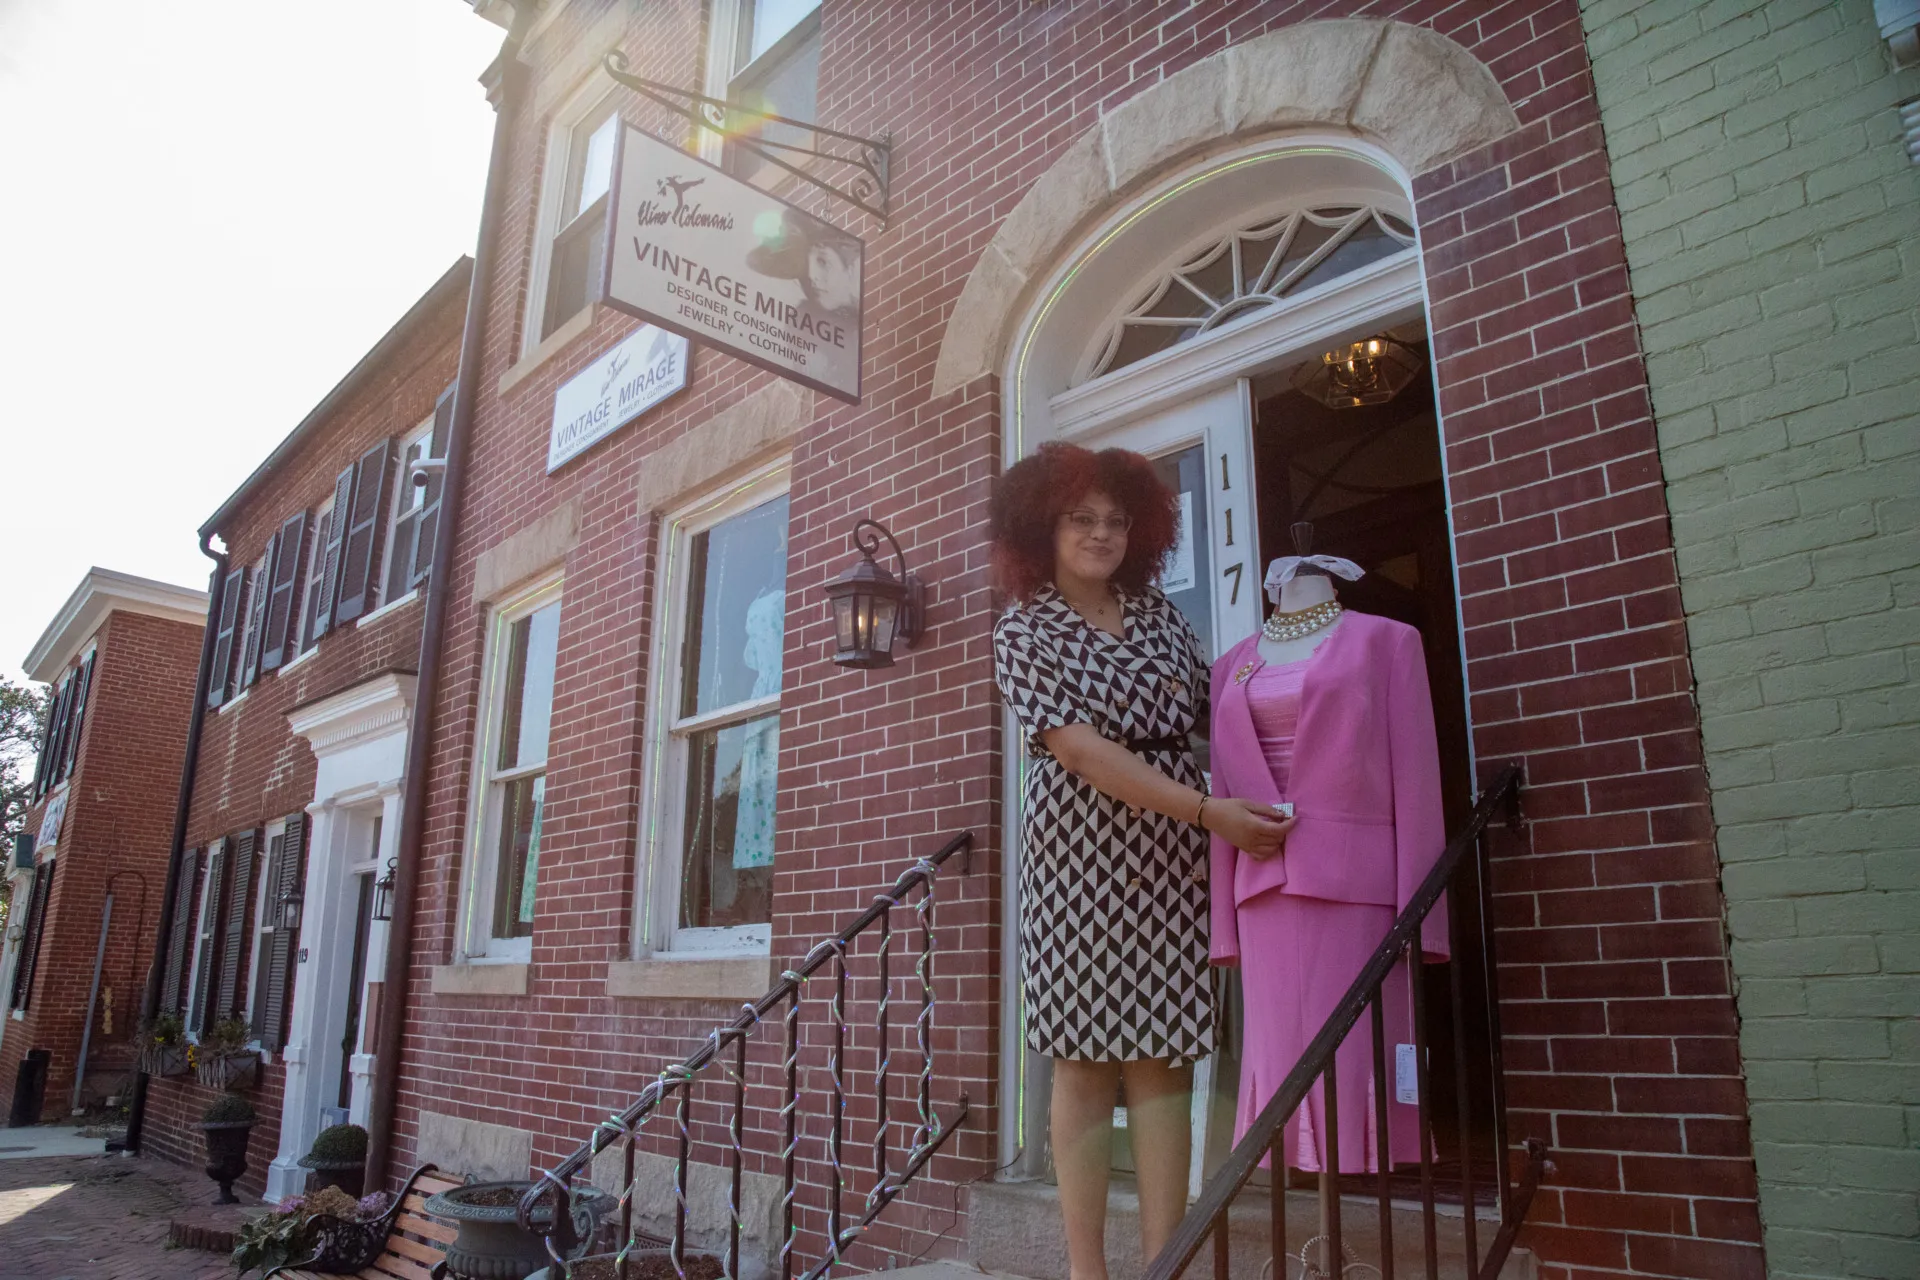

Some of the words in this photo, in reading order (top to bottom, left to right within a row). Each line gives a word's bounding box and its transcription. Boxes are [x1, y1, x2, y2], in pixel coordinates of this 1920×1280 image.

[679, 203, 734, 231] Coleman's
[633, 236, 747, 306] VINTAGE
[754, 291, 845, 349] MIRAGE
[667, 281, 728, 317] DESIGNER
[733, 310, 818, 354] CONSIGNMENT
[677, 303, 734, 335] JEWELRY
[748, 333, 807, 366] CLOTHING
[557, 396, 612, 449] VINTAGE
[618, 352, 676, 408] MIRAGE
[646, 377, 675, 400] CLOTHING
[1220, 453, 1243, 606] 117
